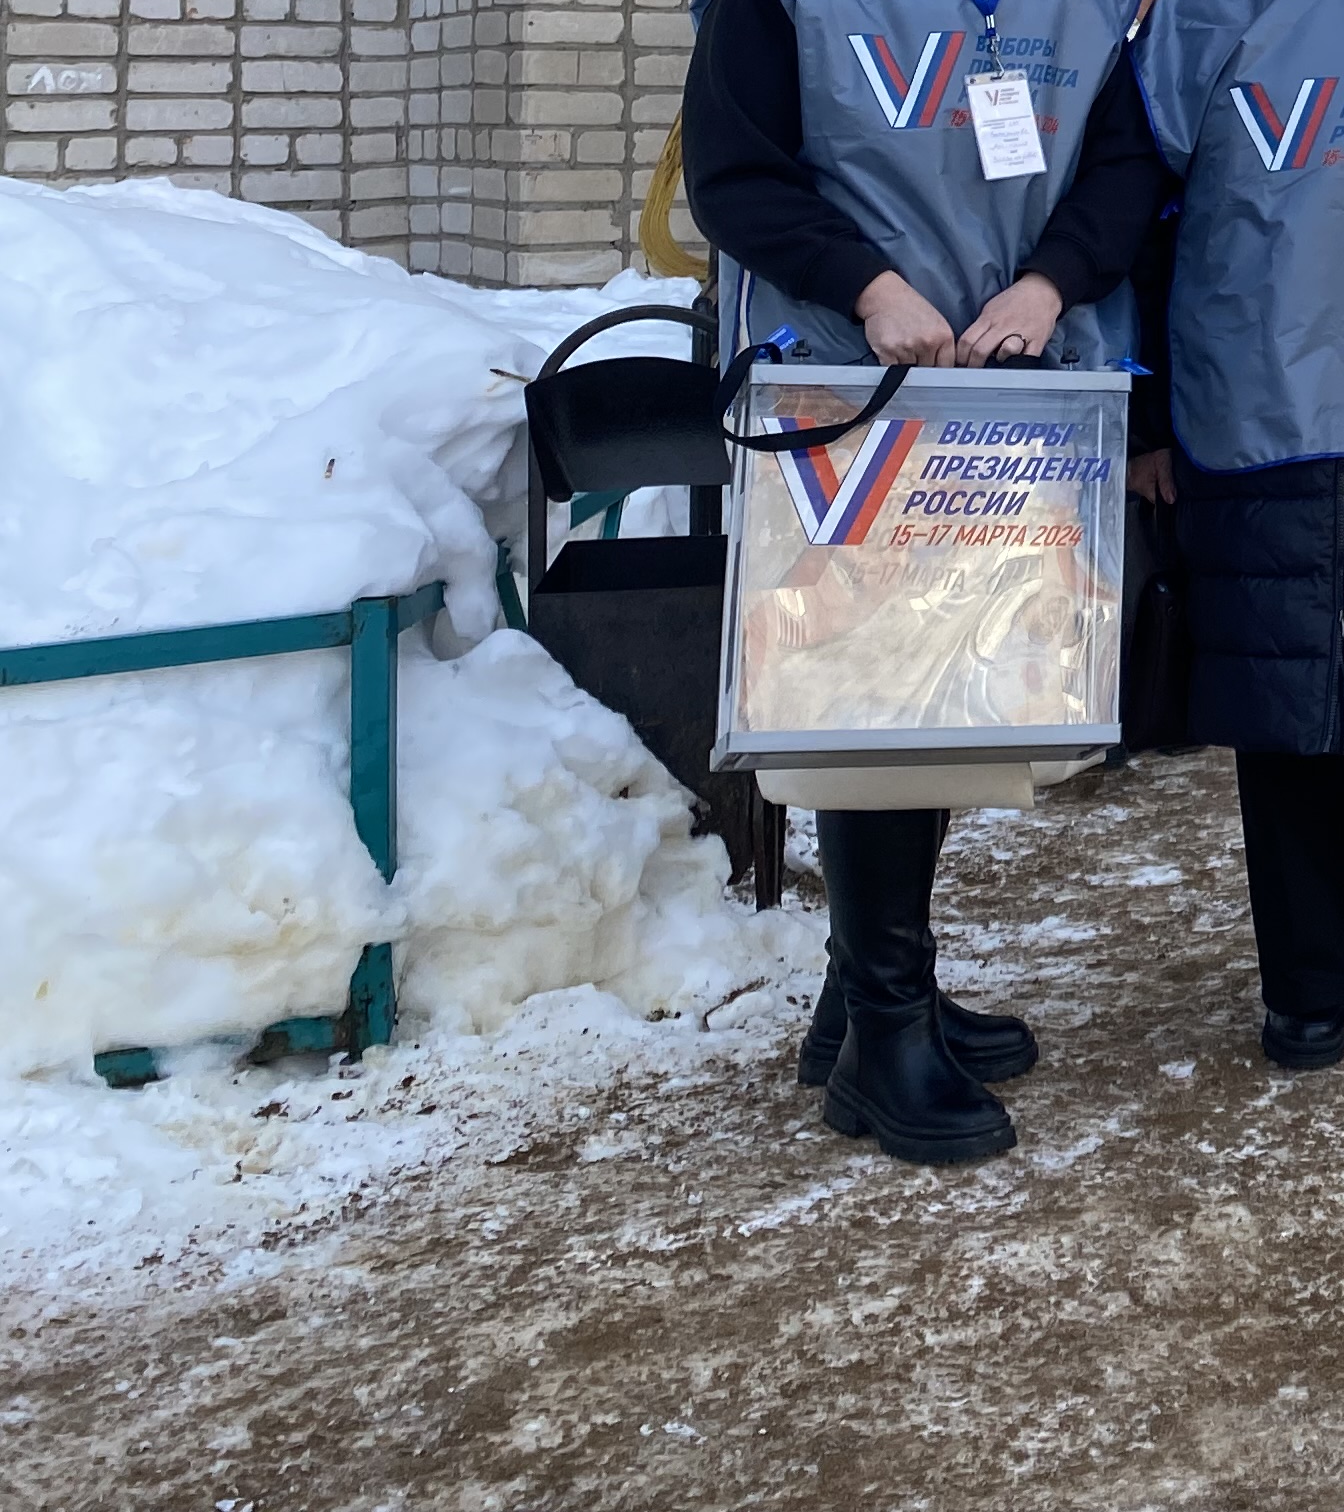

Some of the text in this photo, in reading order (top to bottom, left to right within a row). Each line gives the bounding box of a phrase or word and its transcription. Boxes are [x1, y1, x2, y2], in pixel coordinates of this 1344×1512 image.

[976, 36, 1058, 58] ВБОРЫ
[937, 421, 1076, 447] ВЫБОРЫ
[919, 455, 1112, 485] ПРЕЗИДЕНТА
[902, 490, 1030, 516] РОССИИ
[952, 525, 1027, 547] МАРТА
[1029, 525, 1085, 547] 2024
